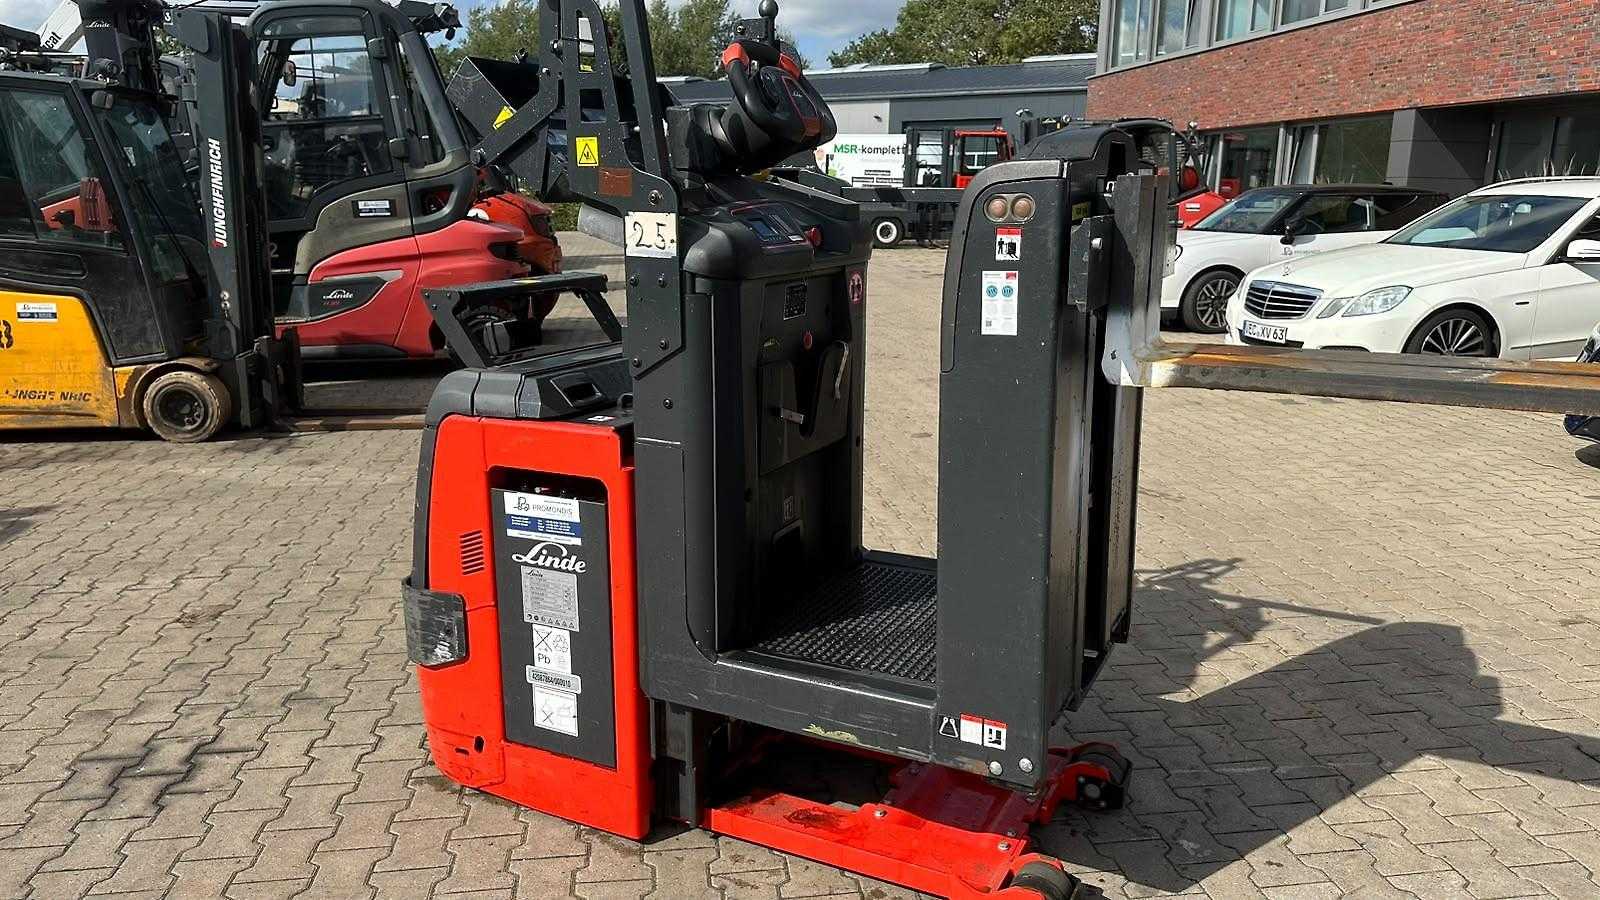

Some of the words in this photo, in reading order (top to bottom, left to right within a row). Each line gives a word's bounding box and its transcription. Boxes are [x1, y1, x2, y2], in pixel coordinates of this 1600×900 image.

[322, 289, 354, 300] Linde
[1273, 328, 1284, 340] 63
[511, 541, 587, 574] Linde
[537, 652, 551, 665] Pb
